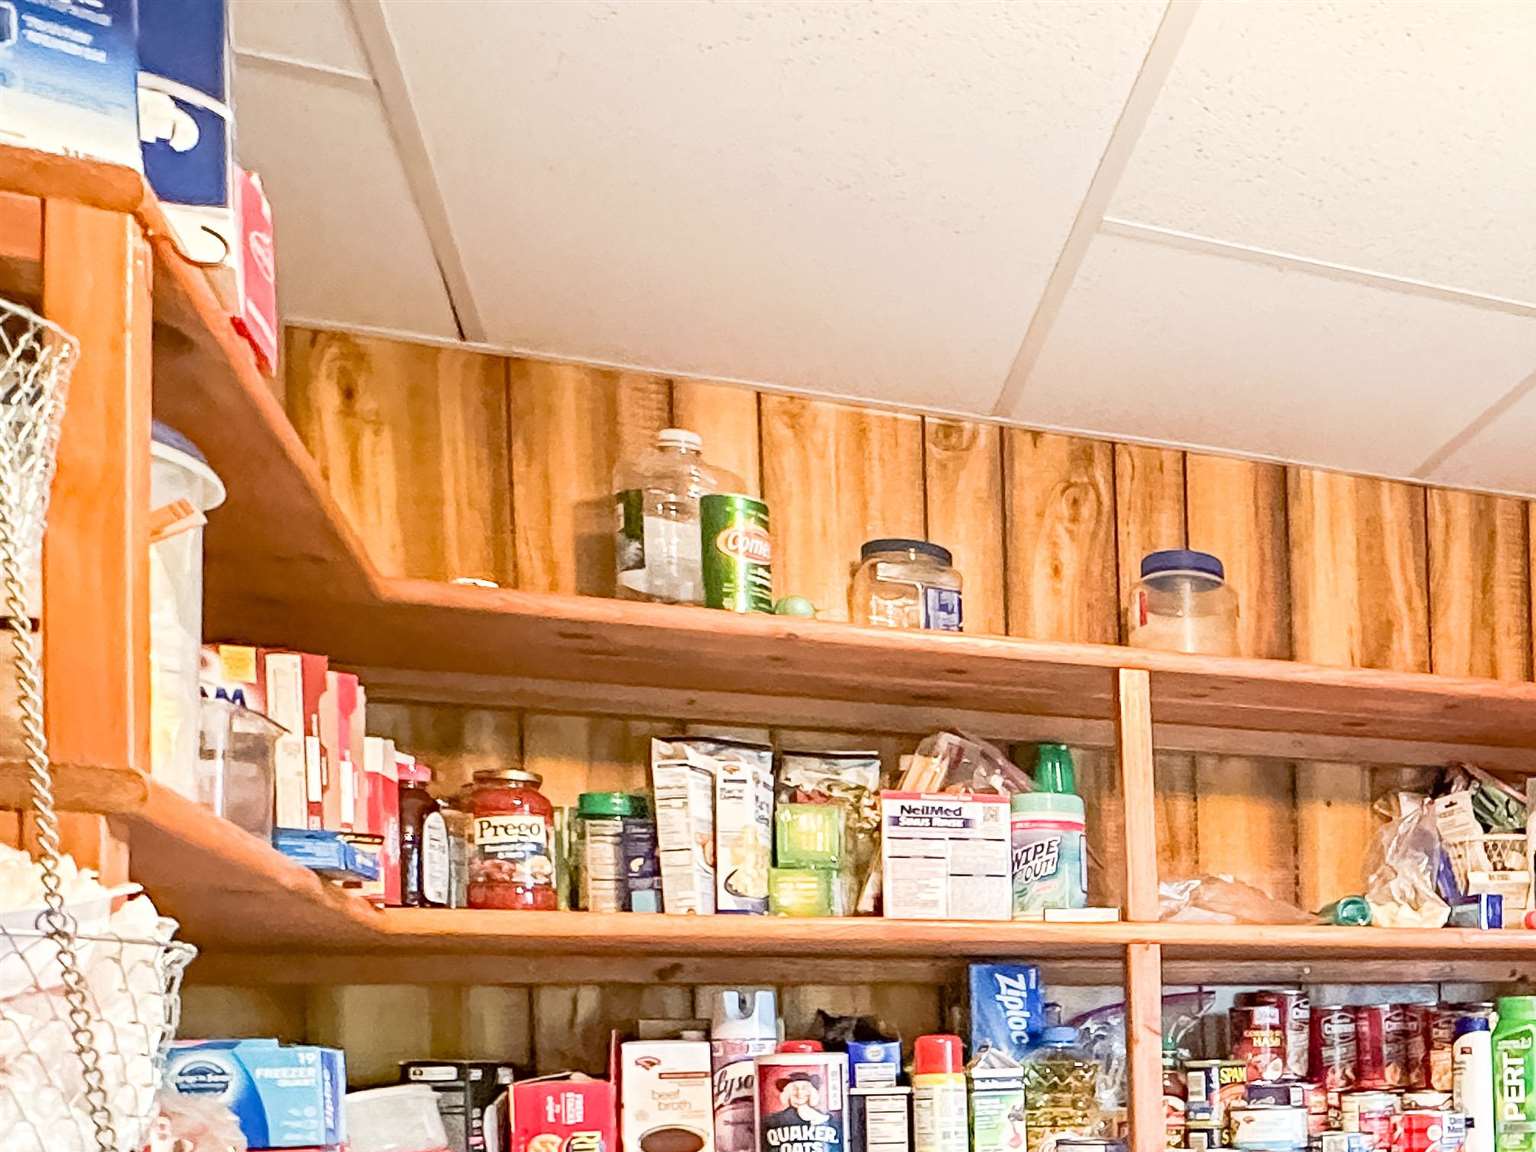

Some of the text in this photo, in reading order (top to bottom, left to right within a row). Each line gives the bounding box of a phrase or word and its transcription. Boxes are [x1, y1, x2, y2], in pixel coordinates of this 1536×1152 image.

[900, 804, 962, 817] NeilMed
[479, 820, 541, 841] Prego
[994, 973, 1031, 1045] Ziploc
[1502, 1047, 1527, 1121] PERT
[767, 1125, 837, 1146] QUAKER
